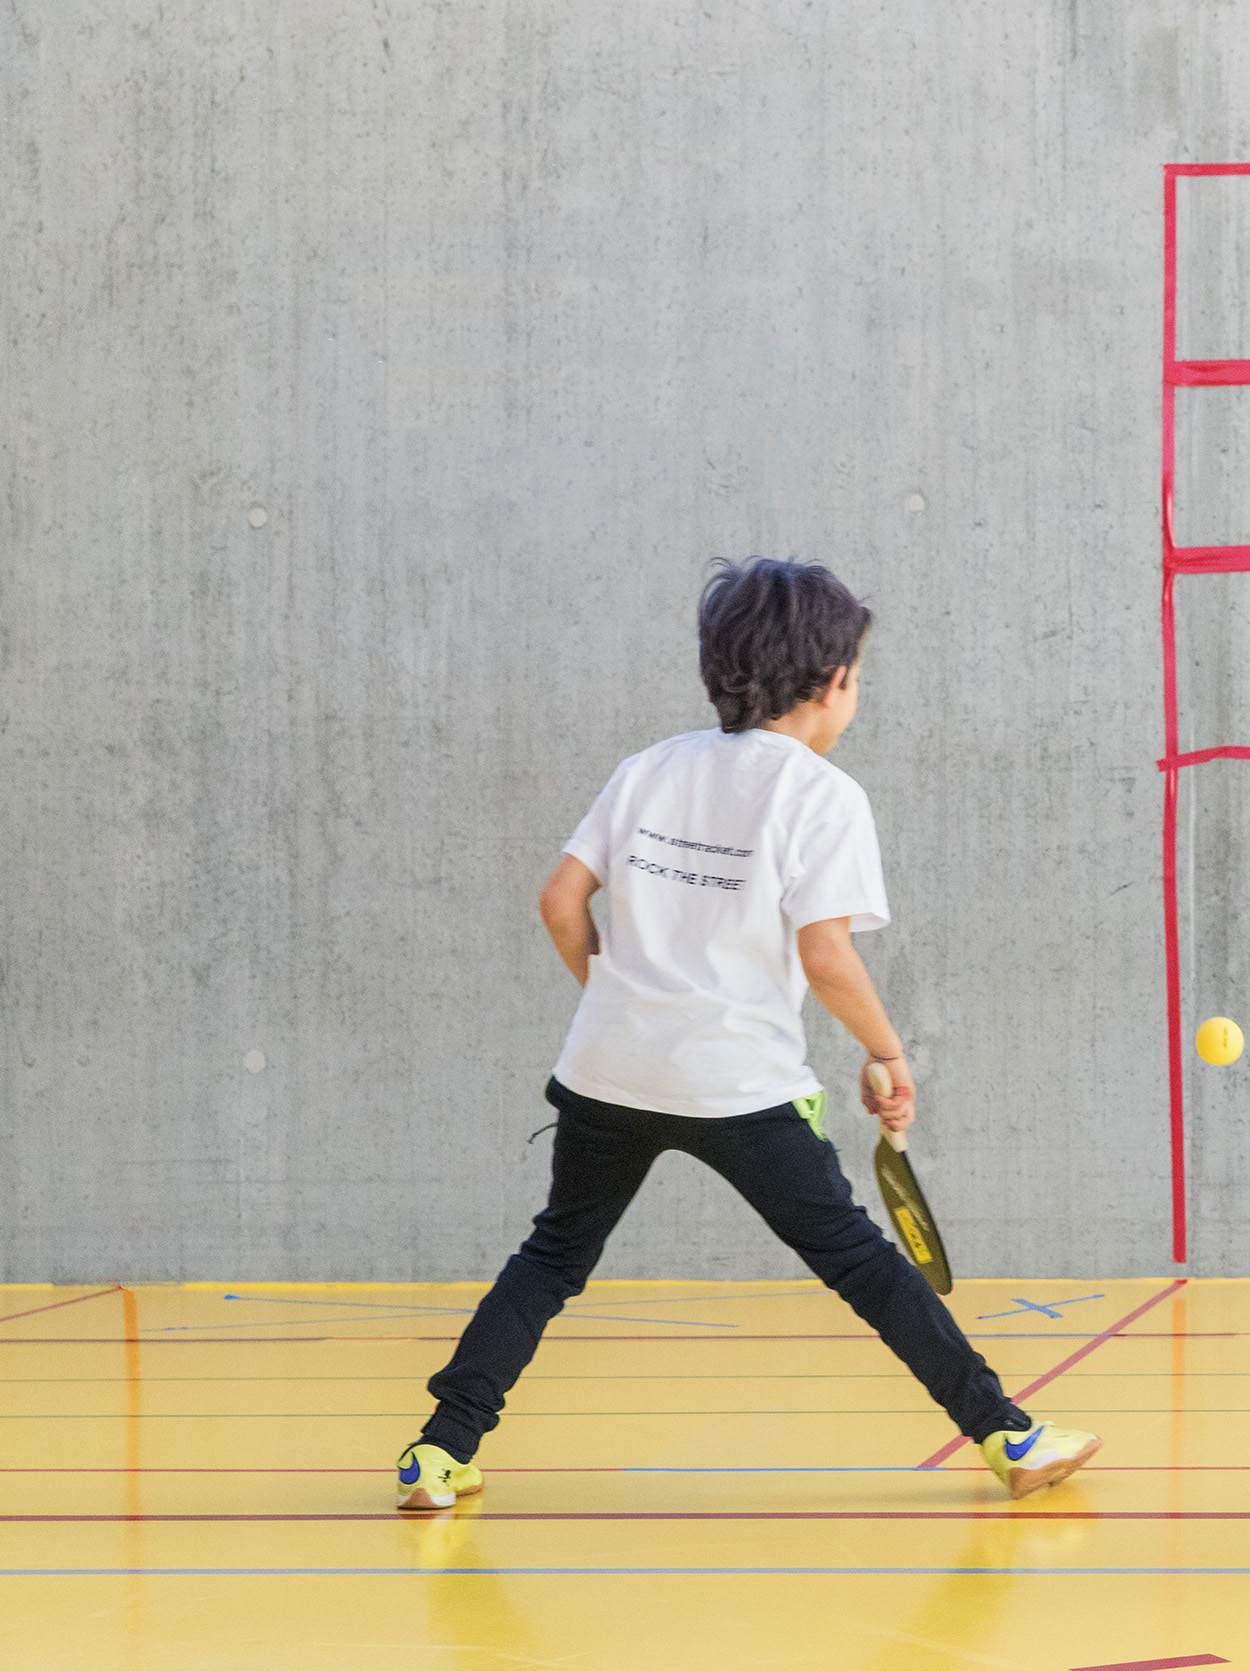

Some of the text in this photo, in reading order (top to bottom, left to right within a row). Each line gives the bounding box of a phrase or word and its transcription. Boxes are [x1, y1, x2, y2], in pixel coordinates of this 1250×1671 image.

[627, 855, 746, 891] ROCK THE STREET
